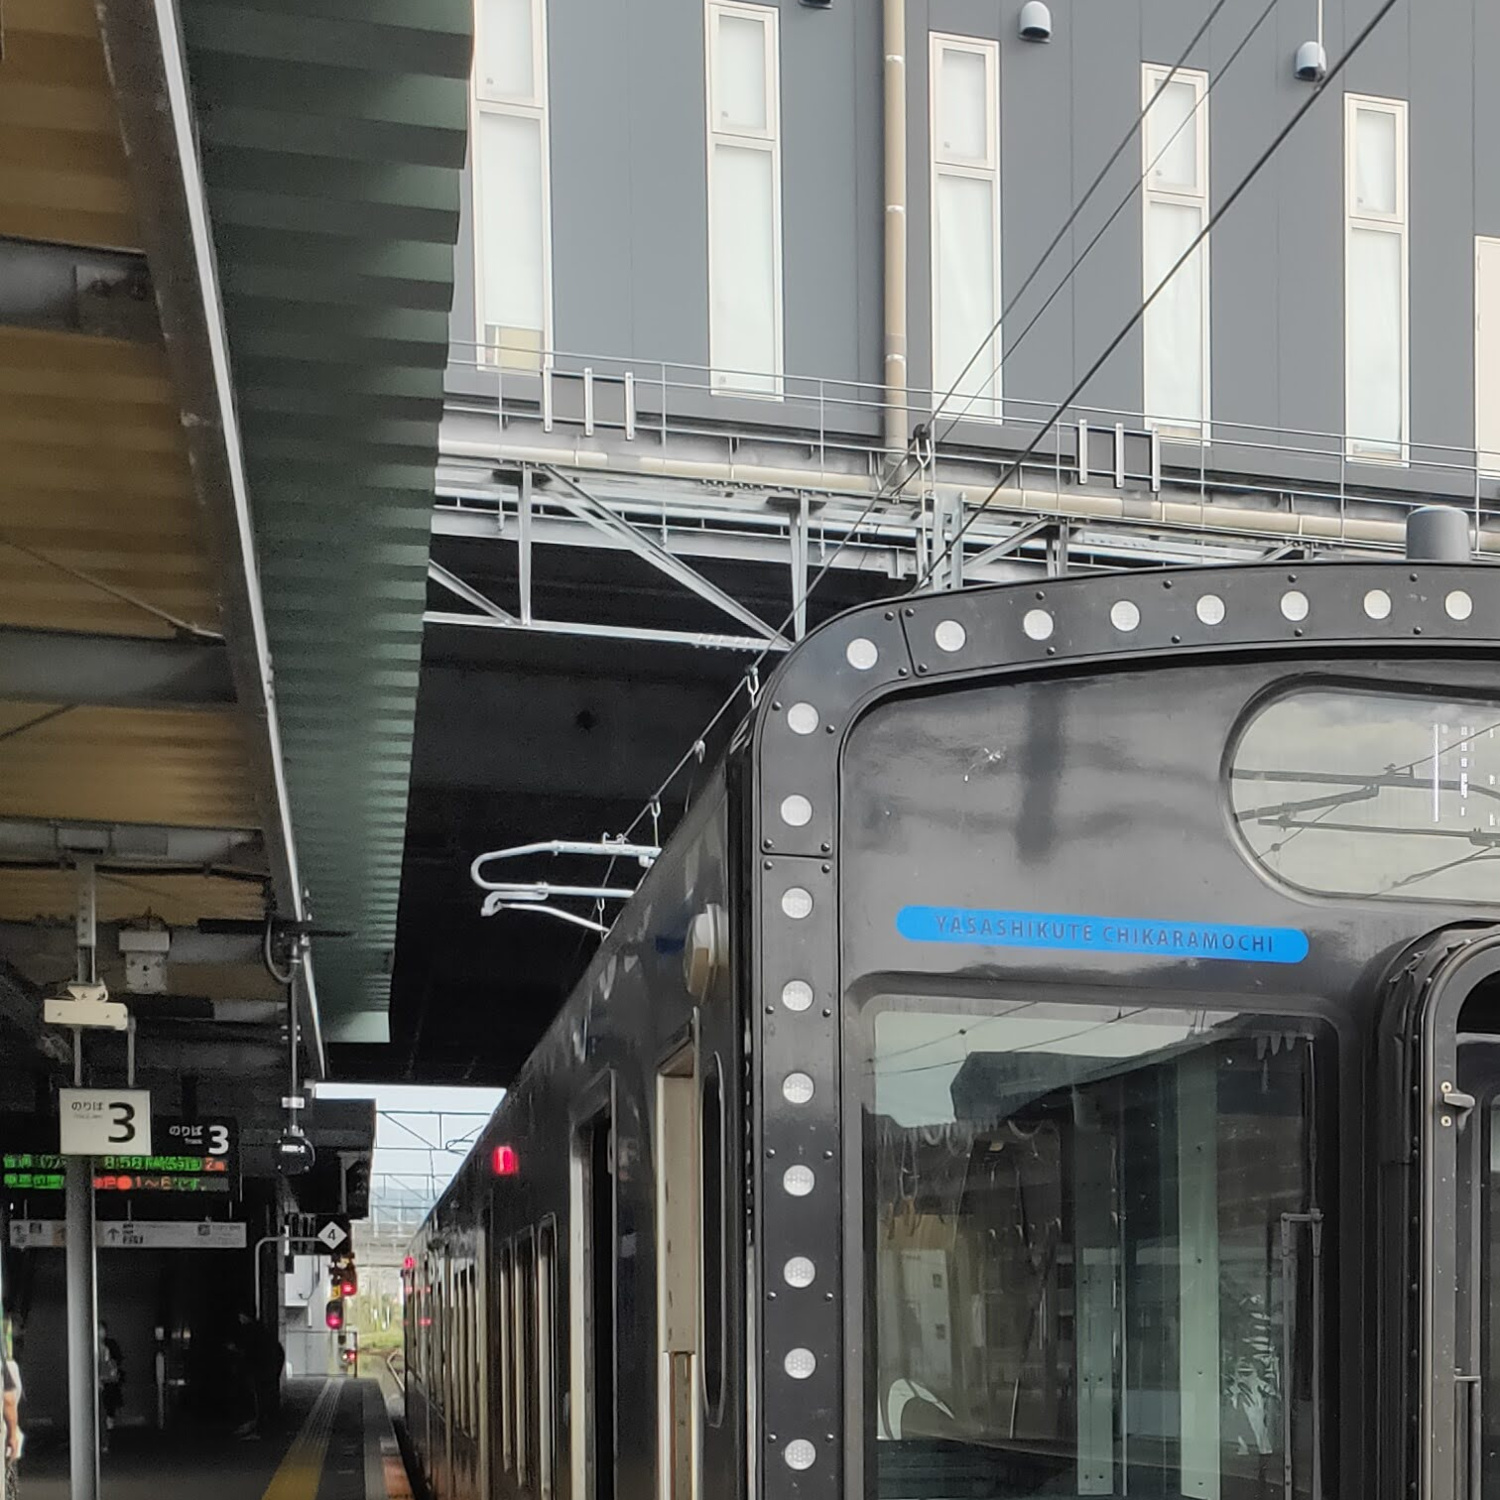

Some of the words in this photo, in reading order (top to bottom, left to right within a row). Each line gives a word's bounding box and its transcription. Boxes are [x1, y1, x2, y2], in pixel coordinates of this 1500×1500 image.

[934, 915, 1093, 942] YASASHIKUTE
[1102, 925, 1274, 953] CHIKARAMOCHI
[71, 1100, 104, 1111] のりば
[107, 1101, 136, 1143] 3
[169, 1124, 204, 1137] のりば
[208, 1124, 229, 1155] 3
[327, 1228, 336, 1241] 4
